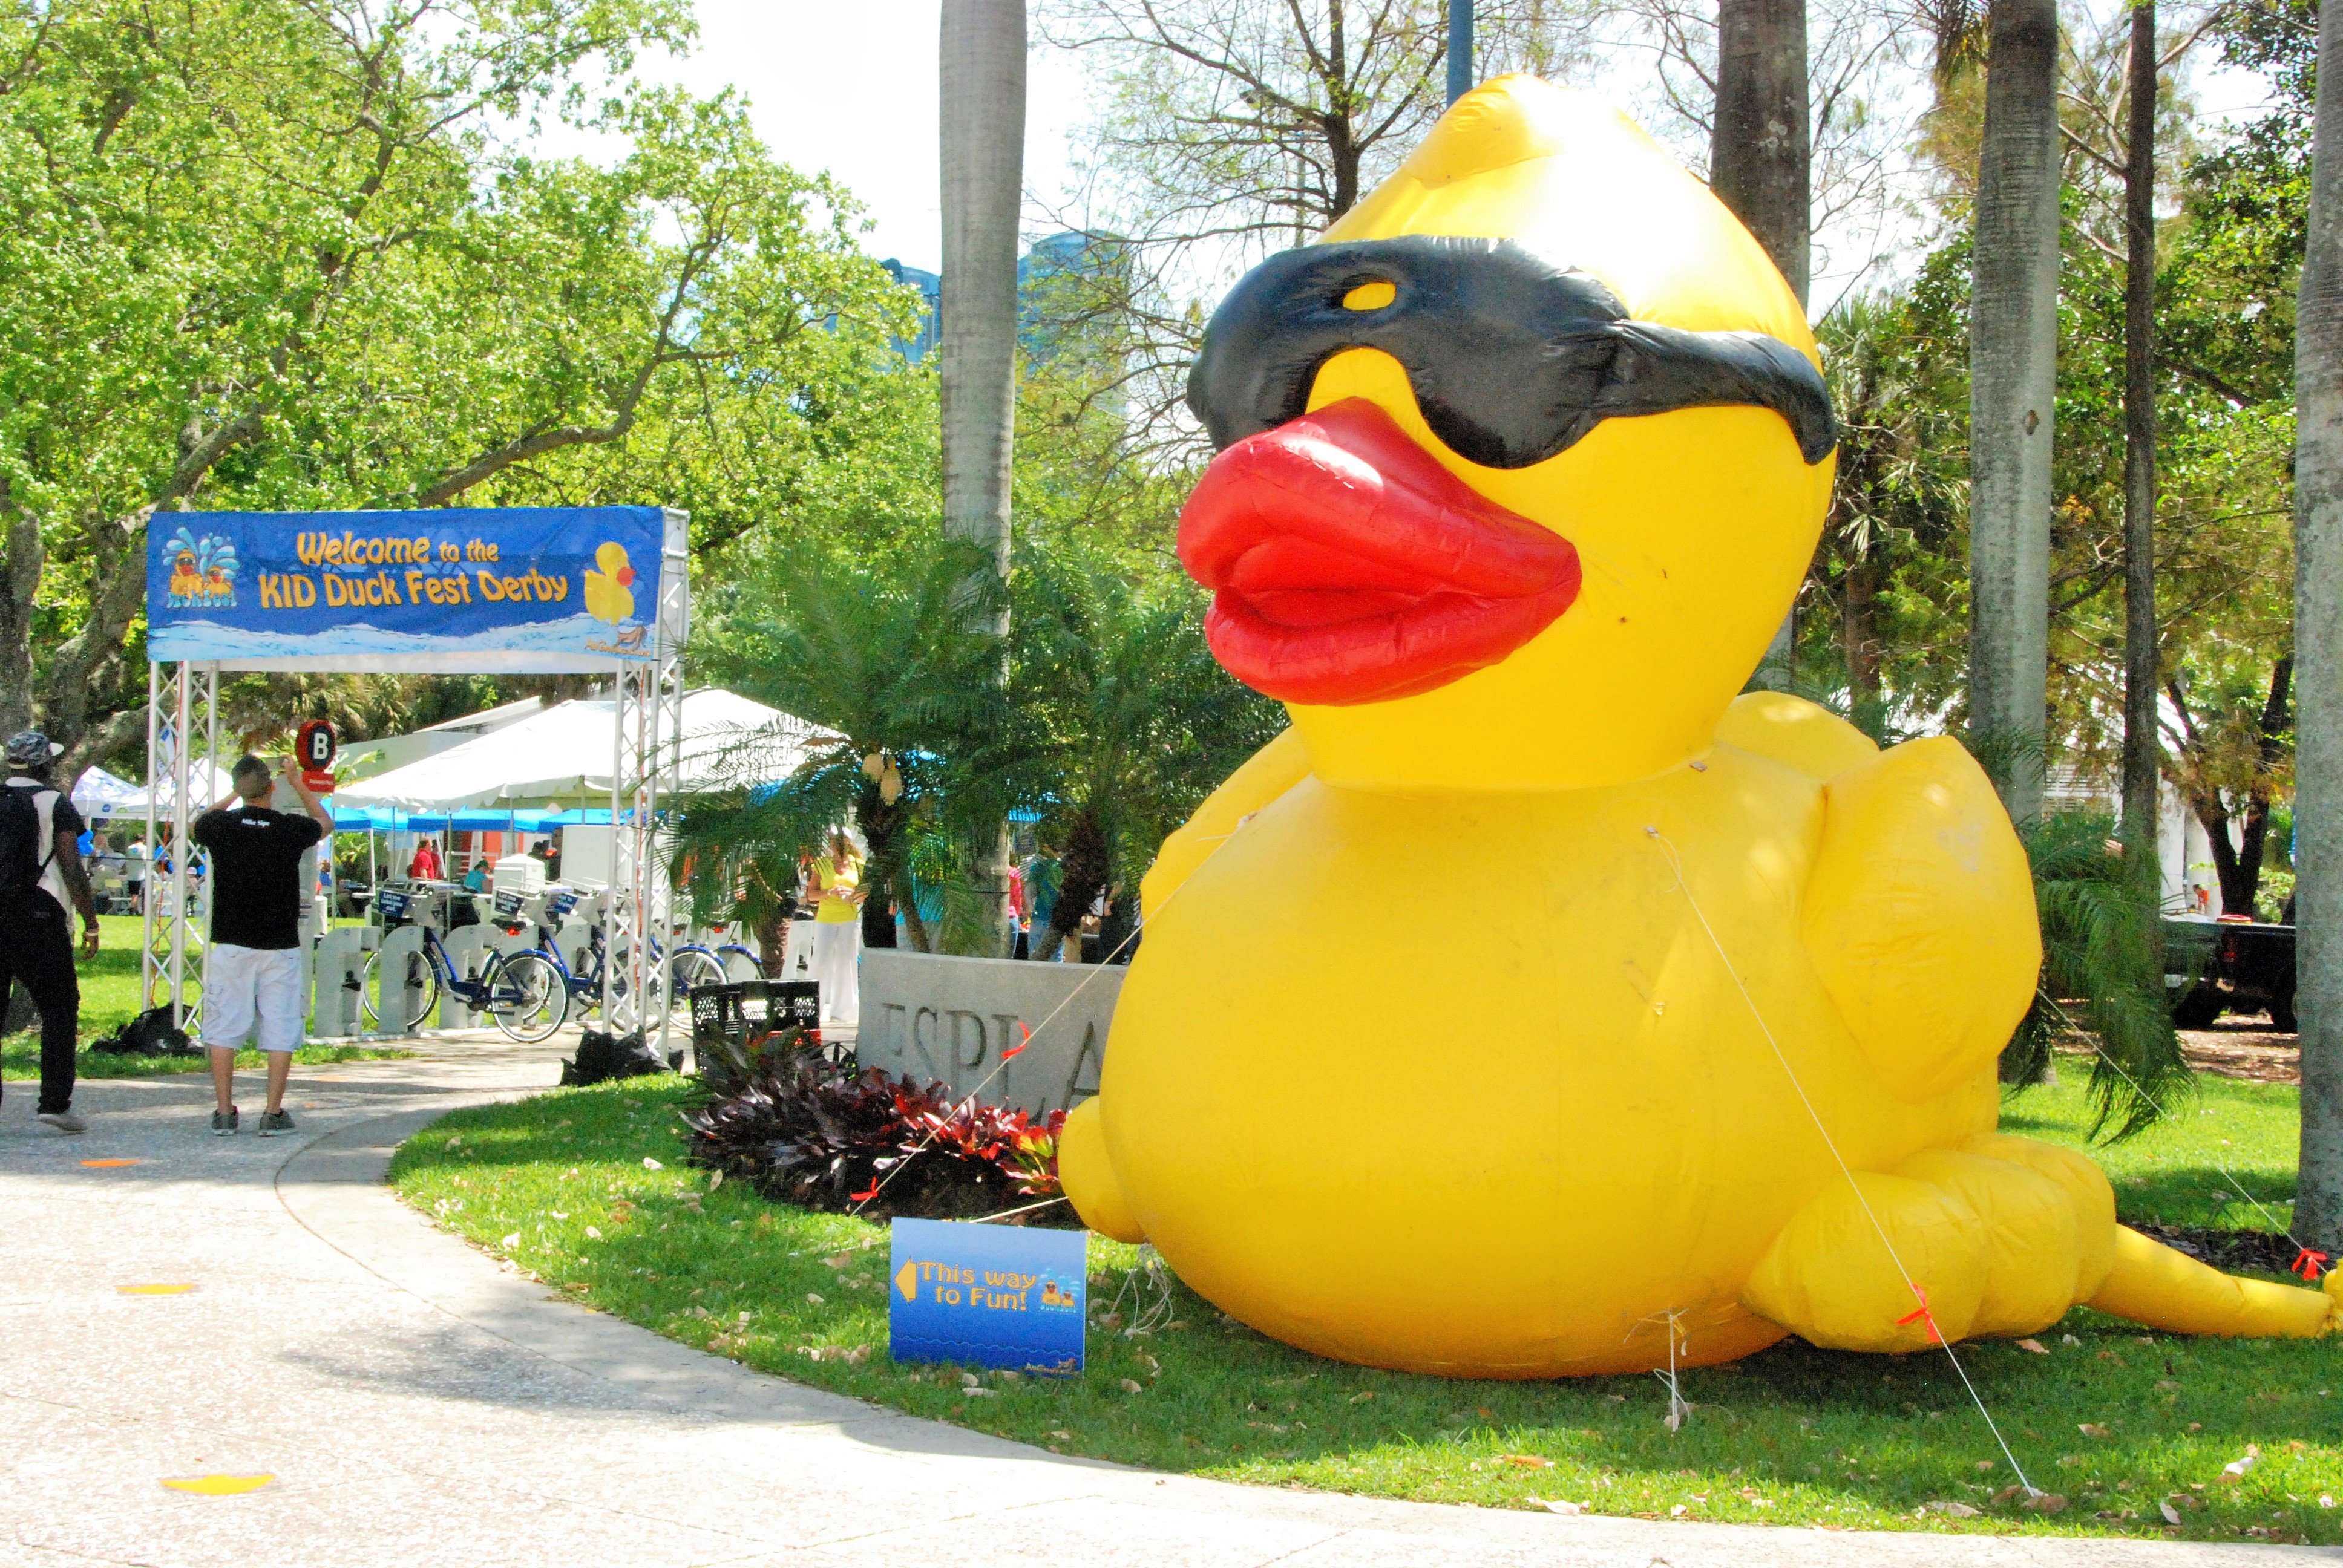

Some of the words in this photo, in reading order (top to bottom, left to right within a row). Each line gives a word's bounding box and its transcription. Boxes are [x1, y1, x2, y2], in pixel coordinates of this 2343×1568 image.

[297, 531, 431, 566] Welcome
[438, 541, 460, 563] to
[465, 538, 499, 563] the
[258, 573, 316, 609] KID
[323, 570, 402, 607] Duck
[404, 570, 472, 605] Fest
[477, 568, 568, 602] Derby
[313, 733, 328, 759] B
[918, 1261, 975, 1284] This
[984, 1270, 1037, 1290] way
[934, 1285, 962, 1305] to
[970, 1286, 1027, 1311] Fun!
